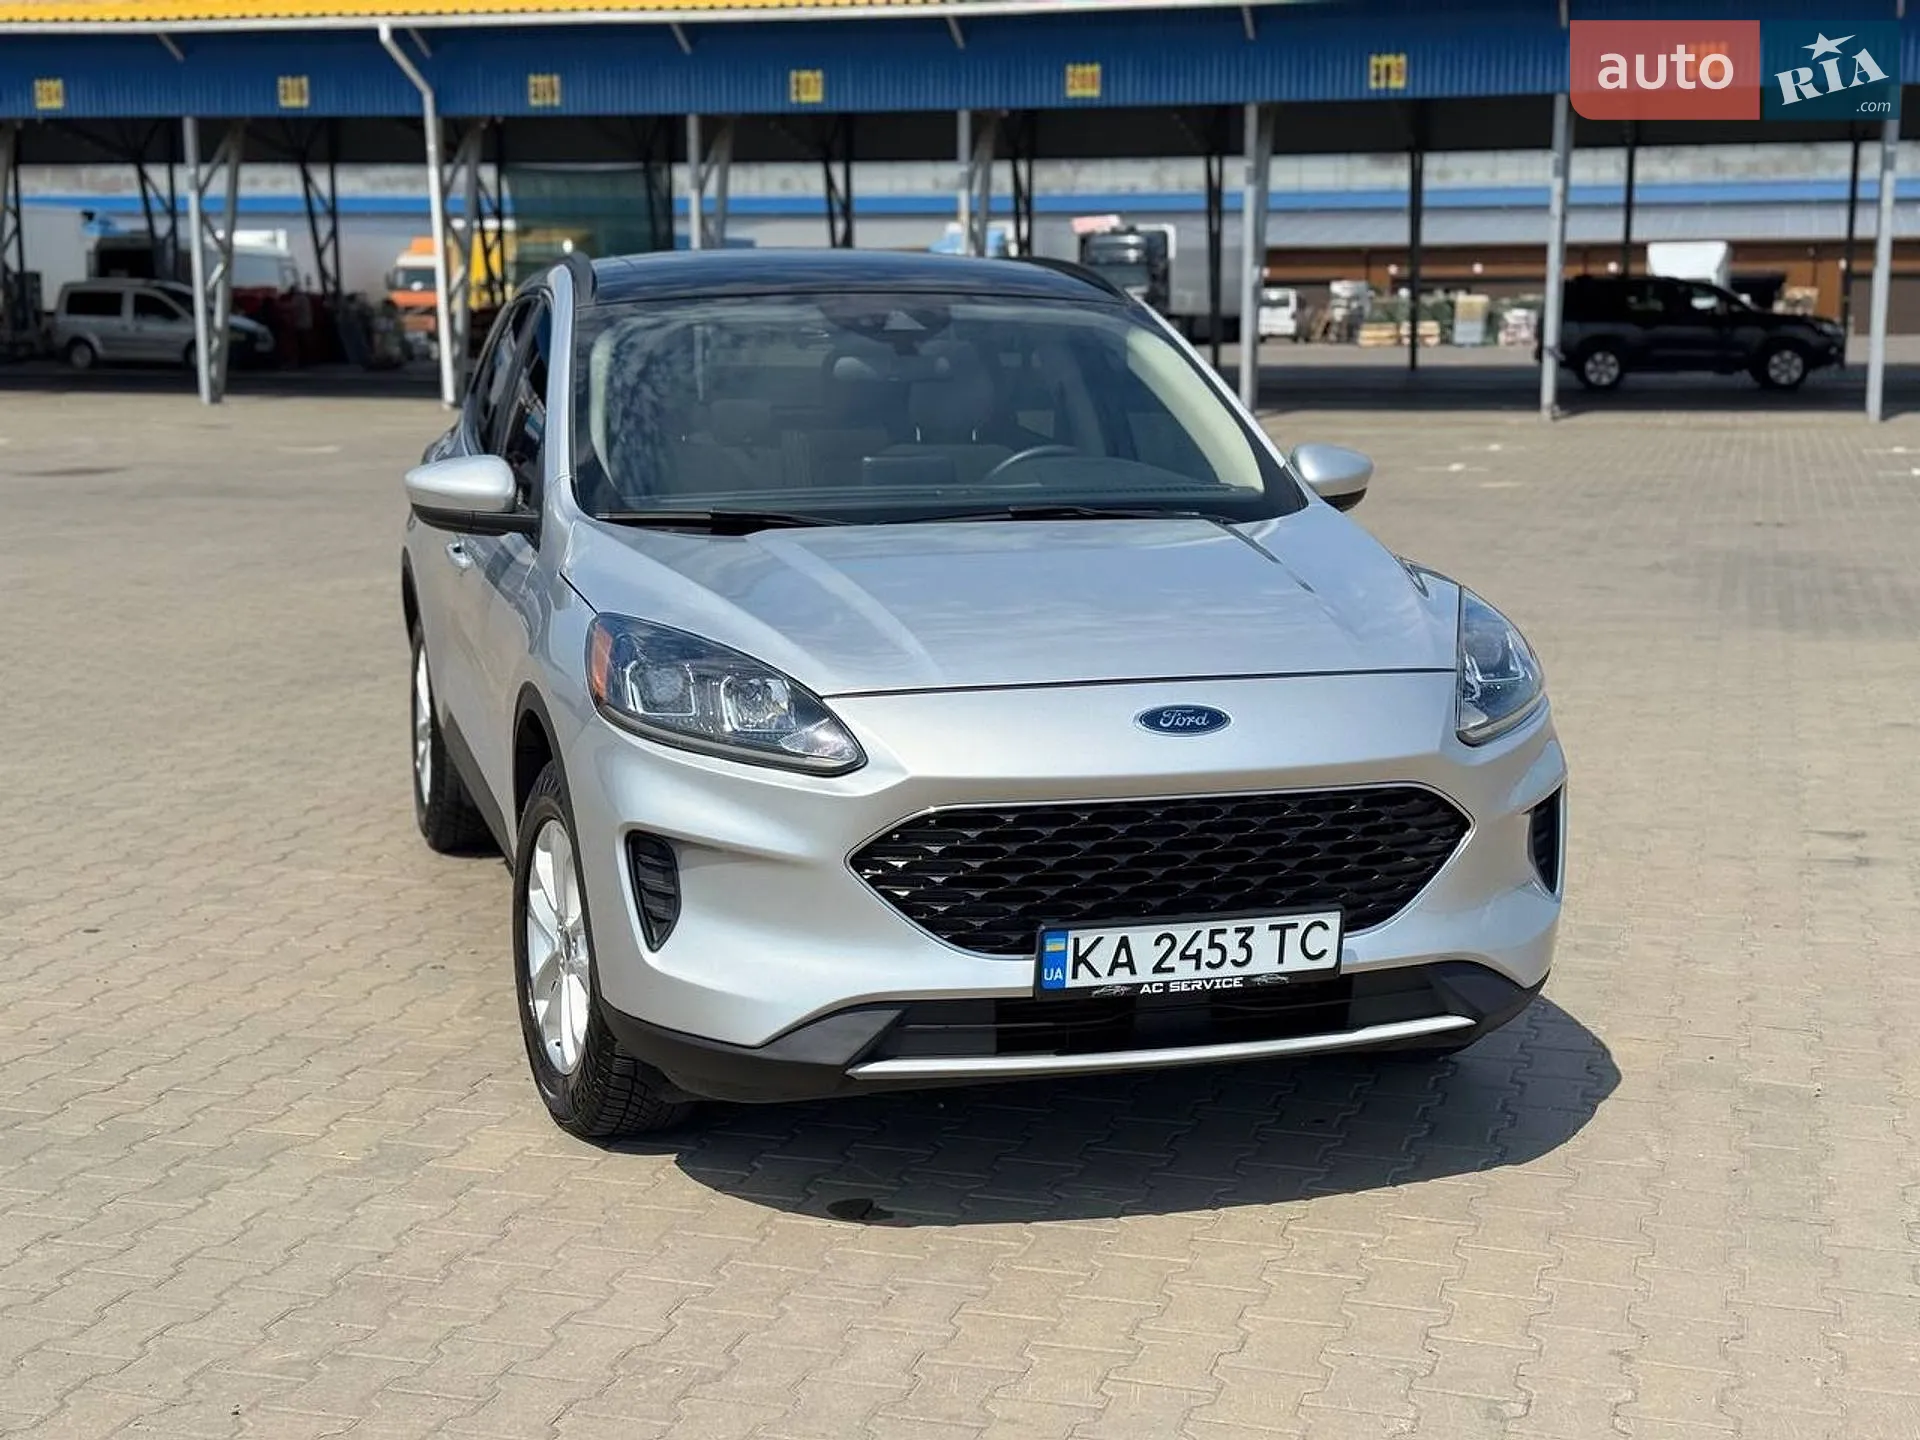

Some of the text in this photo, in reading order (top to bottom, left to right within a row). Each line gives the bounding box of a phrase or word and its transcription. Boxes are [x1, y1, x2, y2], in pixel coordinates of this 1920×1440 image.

[1159, 709, 1209, 727] Ford
[1072, 920, 1330, 980] KA 2453 TC
[1043, 967, 1063, 981] UA
[1140, 977, 1244, 994] AC SERVICE
